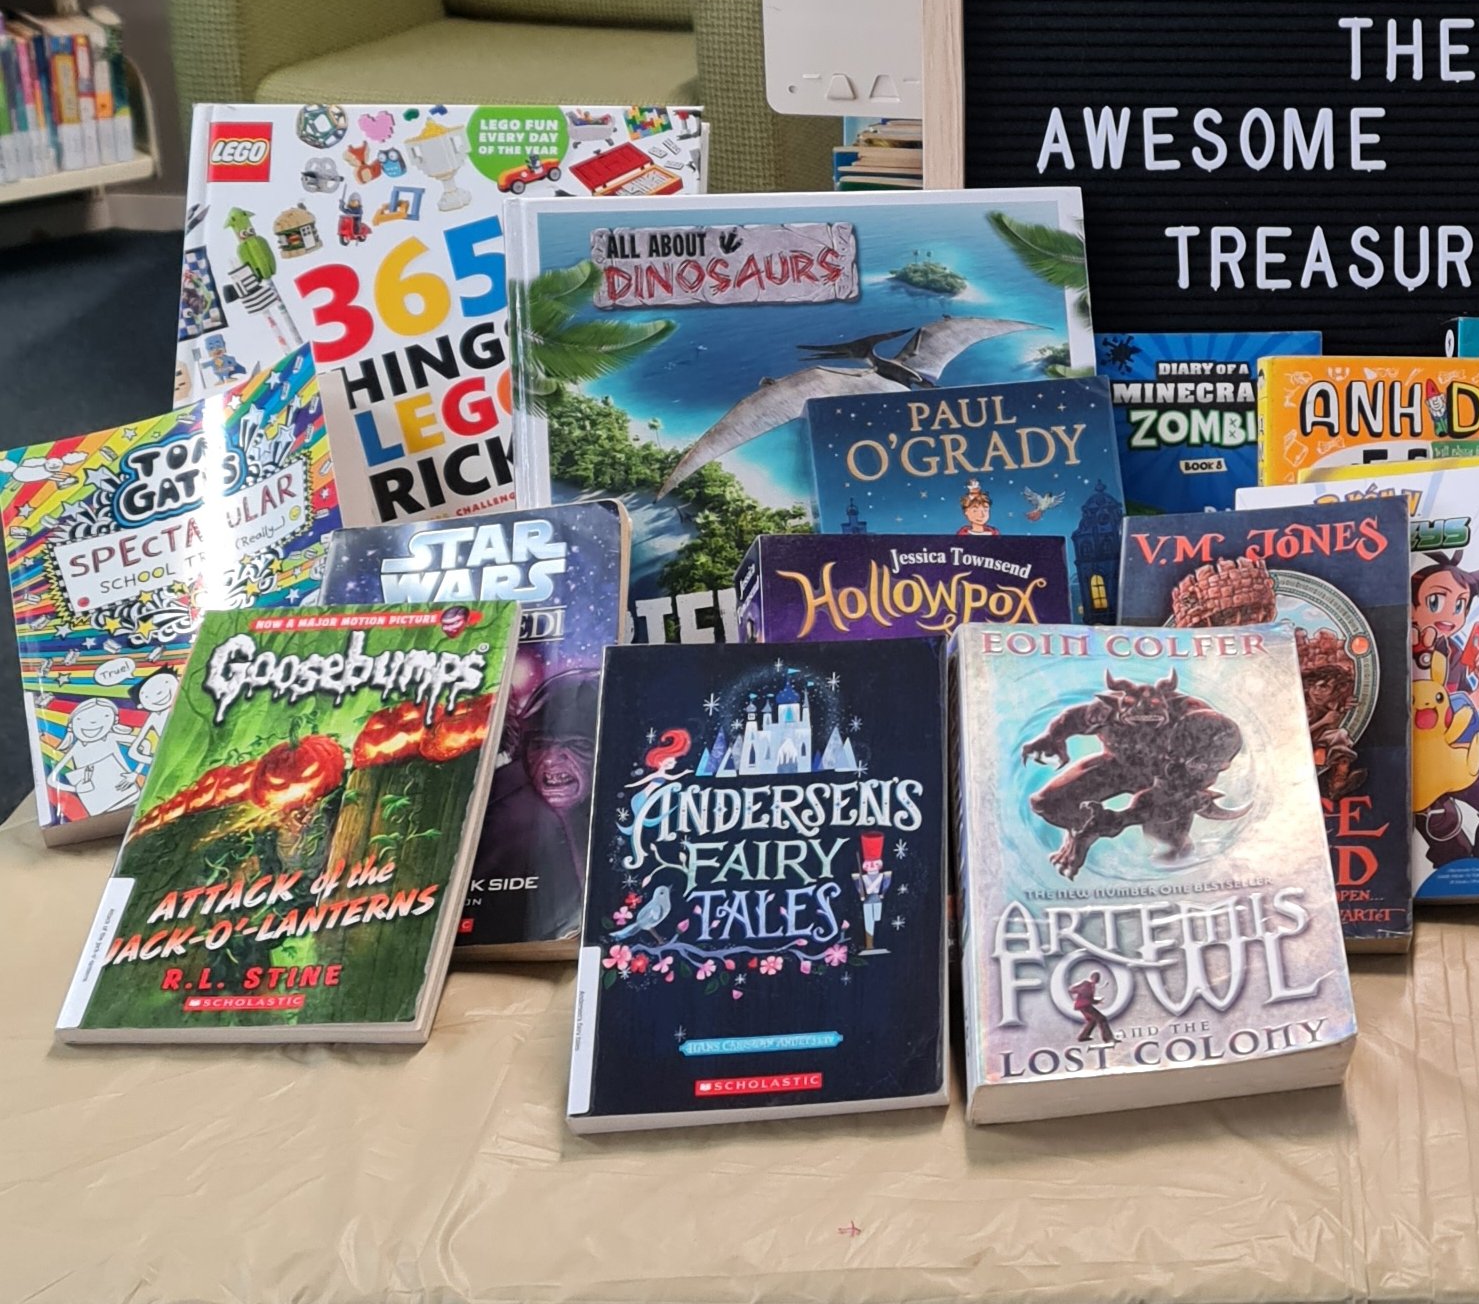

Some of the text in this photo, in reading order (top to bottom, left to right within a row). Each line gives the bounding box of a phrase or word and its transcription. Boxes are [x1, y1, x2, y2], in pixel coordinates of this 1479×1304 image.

[1338, 17, 1476, 83] THE
[479, 131, 559, 145] EVERY DAY
[480, 118, 559, 133] LEGO FUN
[1037, 105, 1387, 173] AWESOME
[211, 135, 270, 165] LEGO
[478, 144, 559, 157] OF THE YEAR
[606, 231, 707, 259] ALL ABOUT
[294, 215, 509, 364] 365
[604, 247, 847, 304] DINOSAURS
[342, 320, 508, 410] HING
[1157, 362, 1249, 376] DIARY OF A
[1112, 381, 1256, 404] MINECRA
[1300, 378, 1426, 438] ANH
[907, 396, 1017, 432] PAUL
[1129, 408, 1258, 448] ZOMBI
[846, 423, 1087, 482] O'GRADY
[1184, 460, 1215, 471] BOOK
[124, 455, 239, 518] GATS
[368, 431, 516, 524] RICK
[455, 491, 516, 517] CHALLENG
[69, 473, 297, 579] SPECTAULAR
[1245, 516, 1389, 562] JONES
[381, 519, 567, 573] STAR
[890, 546, 1033, 580] Jessica Townsend
[100, 562, 176, 595] SCHOOL
[380, 558, 567, 604] WARS
[775, 559, 1048, 638] Hollowpox
[255, 614, 438, 630] NOW A MAJOR MOTION PICTURE
[519, 609, 565, 640] EDI
[982, 631, 1270, 659] EOIN COLFER
[101, 661, 130, 680] True!
[204, 630, 487, 727] Goosebumps
[488, 876, 540, 892] SIDE
[683, 836, 851, 897] FAIRY
[147, 854, 396, 924] ATTACK of the
[1024, 877, 1274, 901] THE NEW NUMBER ONE BESTSELLER
[687, 881, 843, 942] TALES
[991, 887, 1310, 968] ARTEMIS
[161, 964, 343, 991] R.L. STINE
[997, 932, 1337, 1028] FOWL
[203, 996, 303, 1009] SCHOLASTIC
[1169, 1019, 1211, 1034] THE
[1000, 1017, 1329, 1079] LOST COLONY
[714, 1077, 819, 1091] SCHOLASTIC
